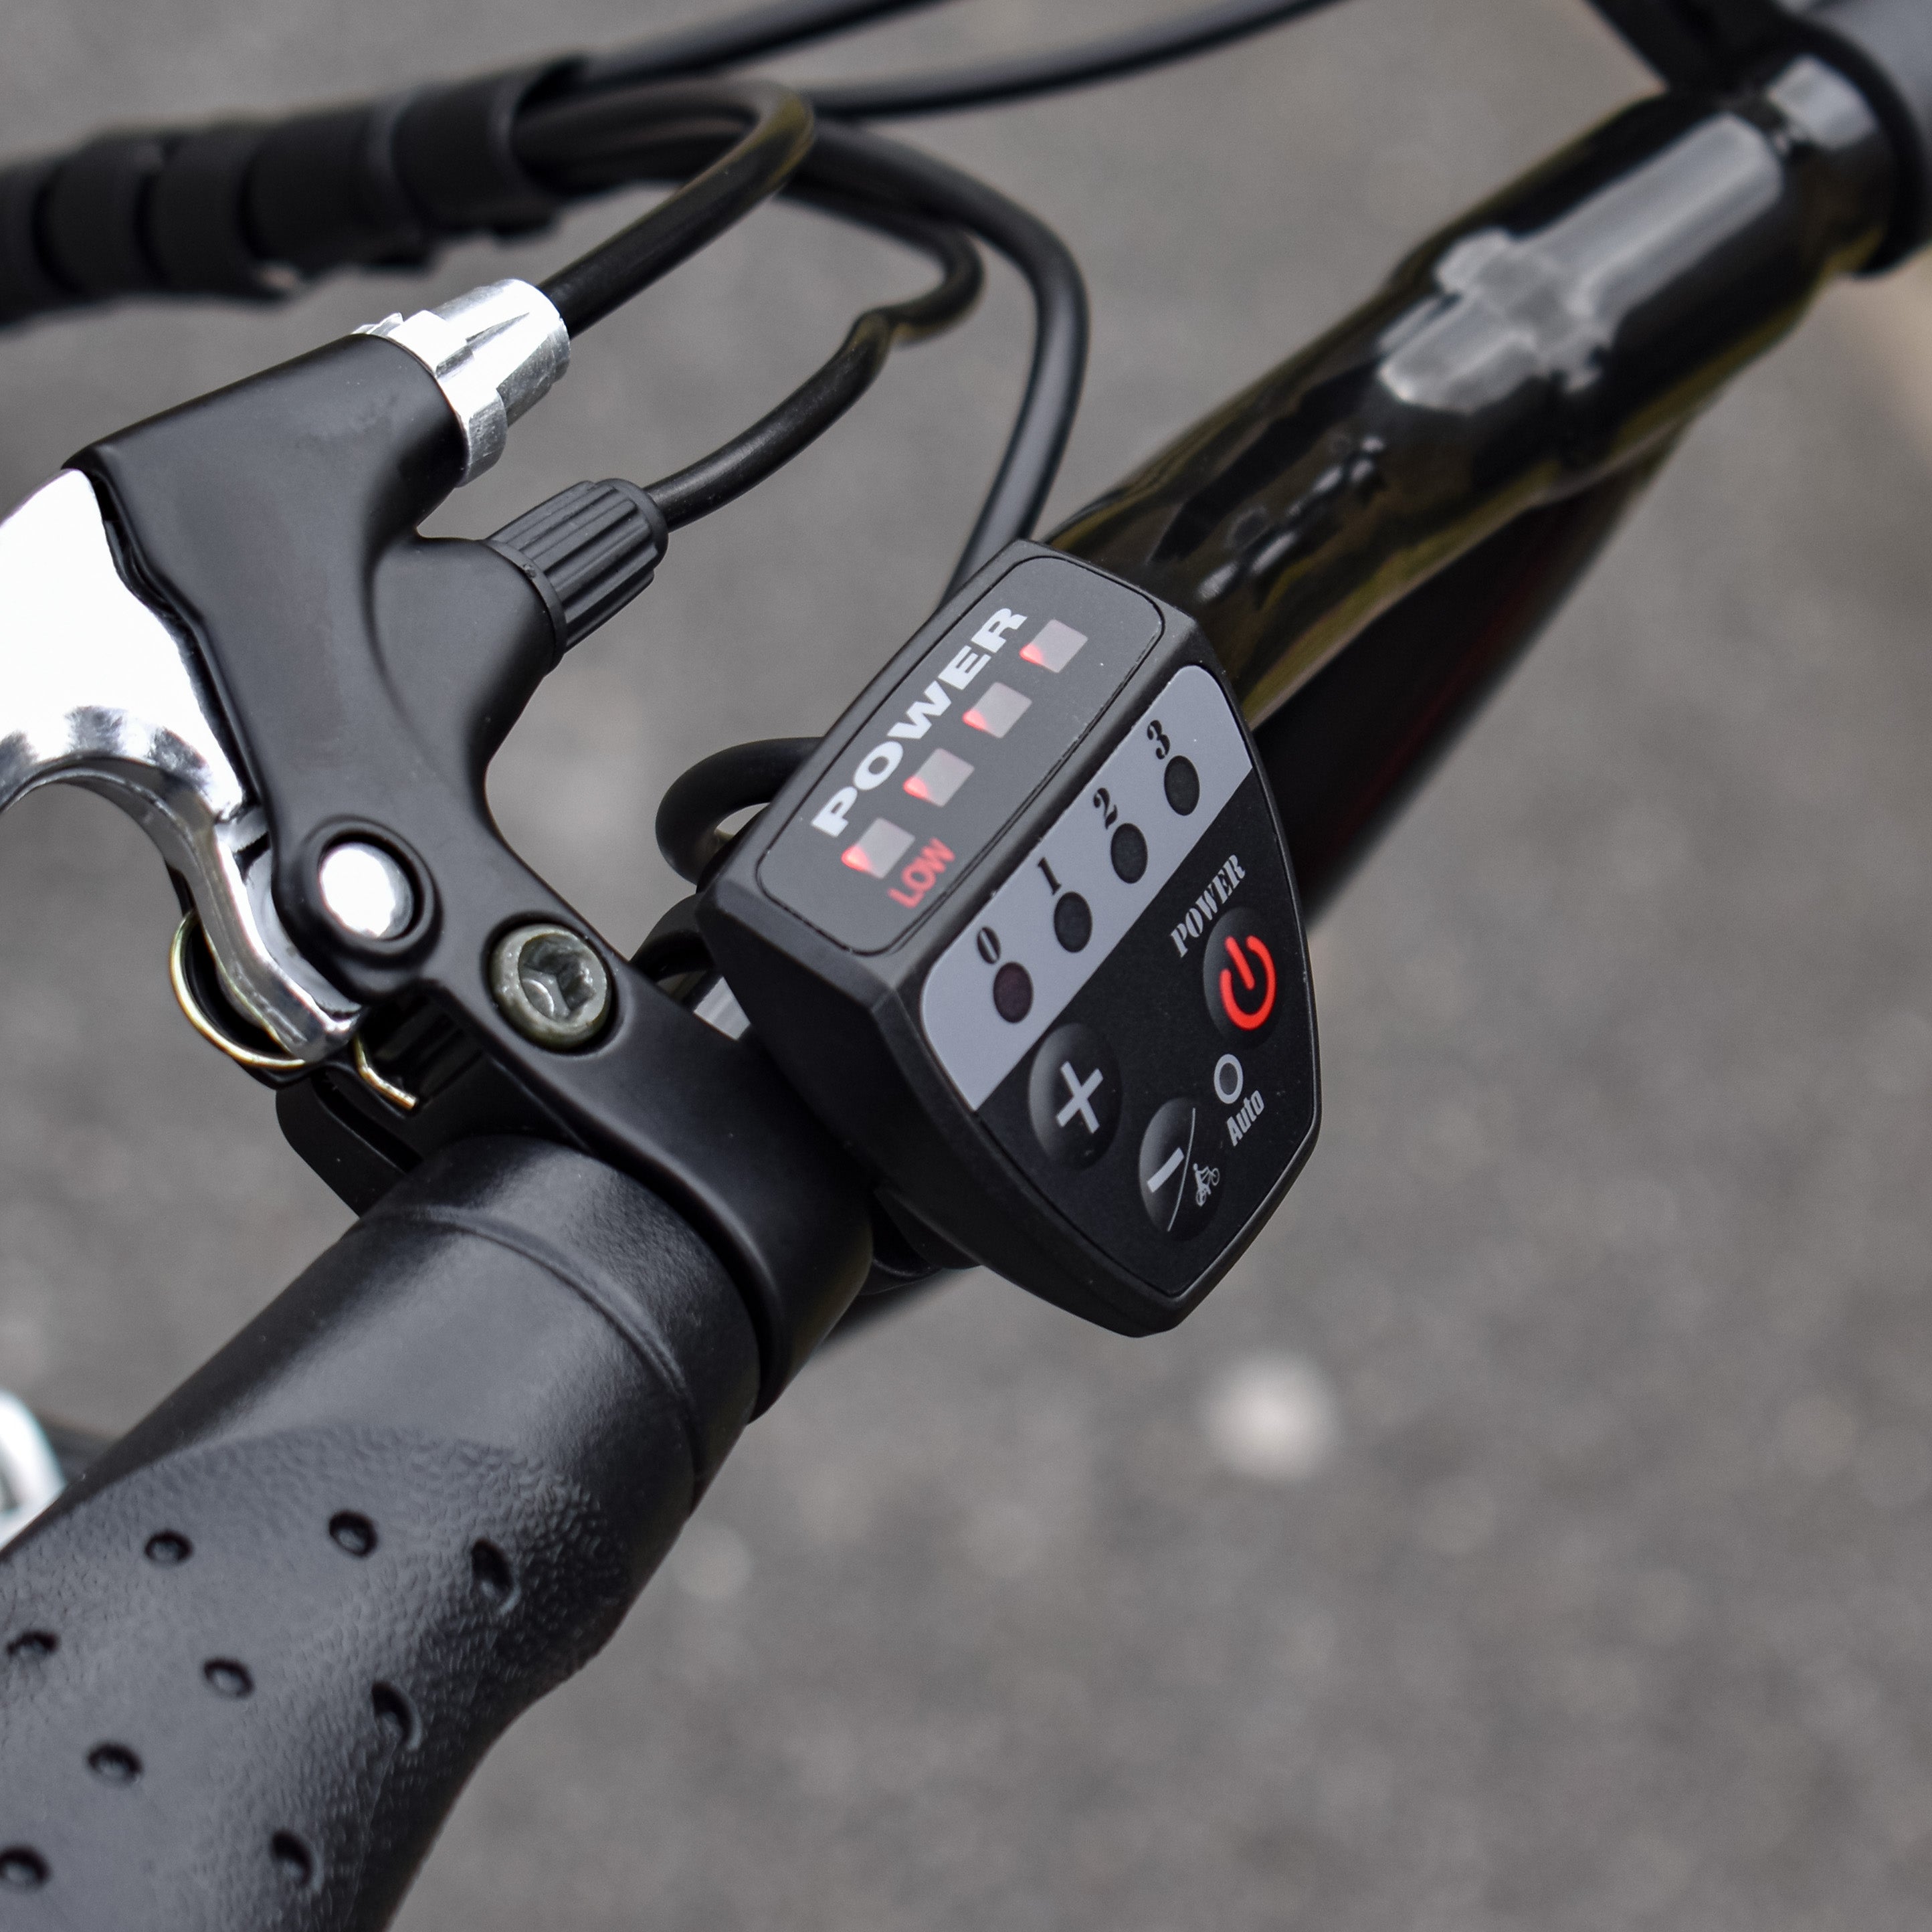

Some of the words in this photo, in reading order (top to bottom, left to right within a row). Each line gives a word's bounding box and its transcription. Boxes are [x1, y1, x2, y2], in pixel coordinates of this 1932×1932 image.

[810, 607, 1028, 838] POWER
[886, 838, 956, 909] LOW
[975, 926, 1001, 965] 0
[1037, 856, 1062, 895] 1
[1092, 787, 1118, 830] 2
[1146, 718, 1171, 759] 3
[1169, 854, 1247, 958] POWER
[1226, 1088, 1265, 1147] Auto
